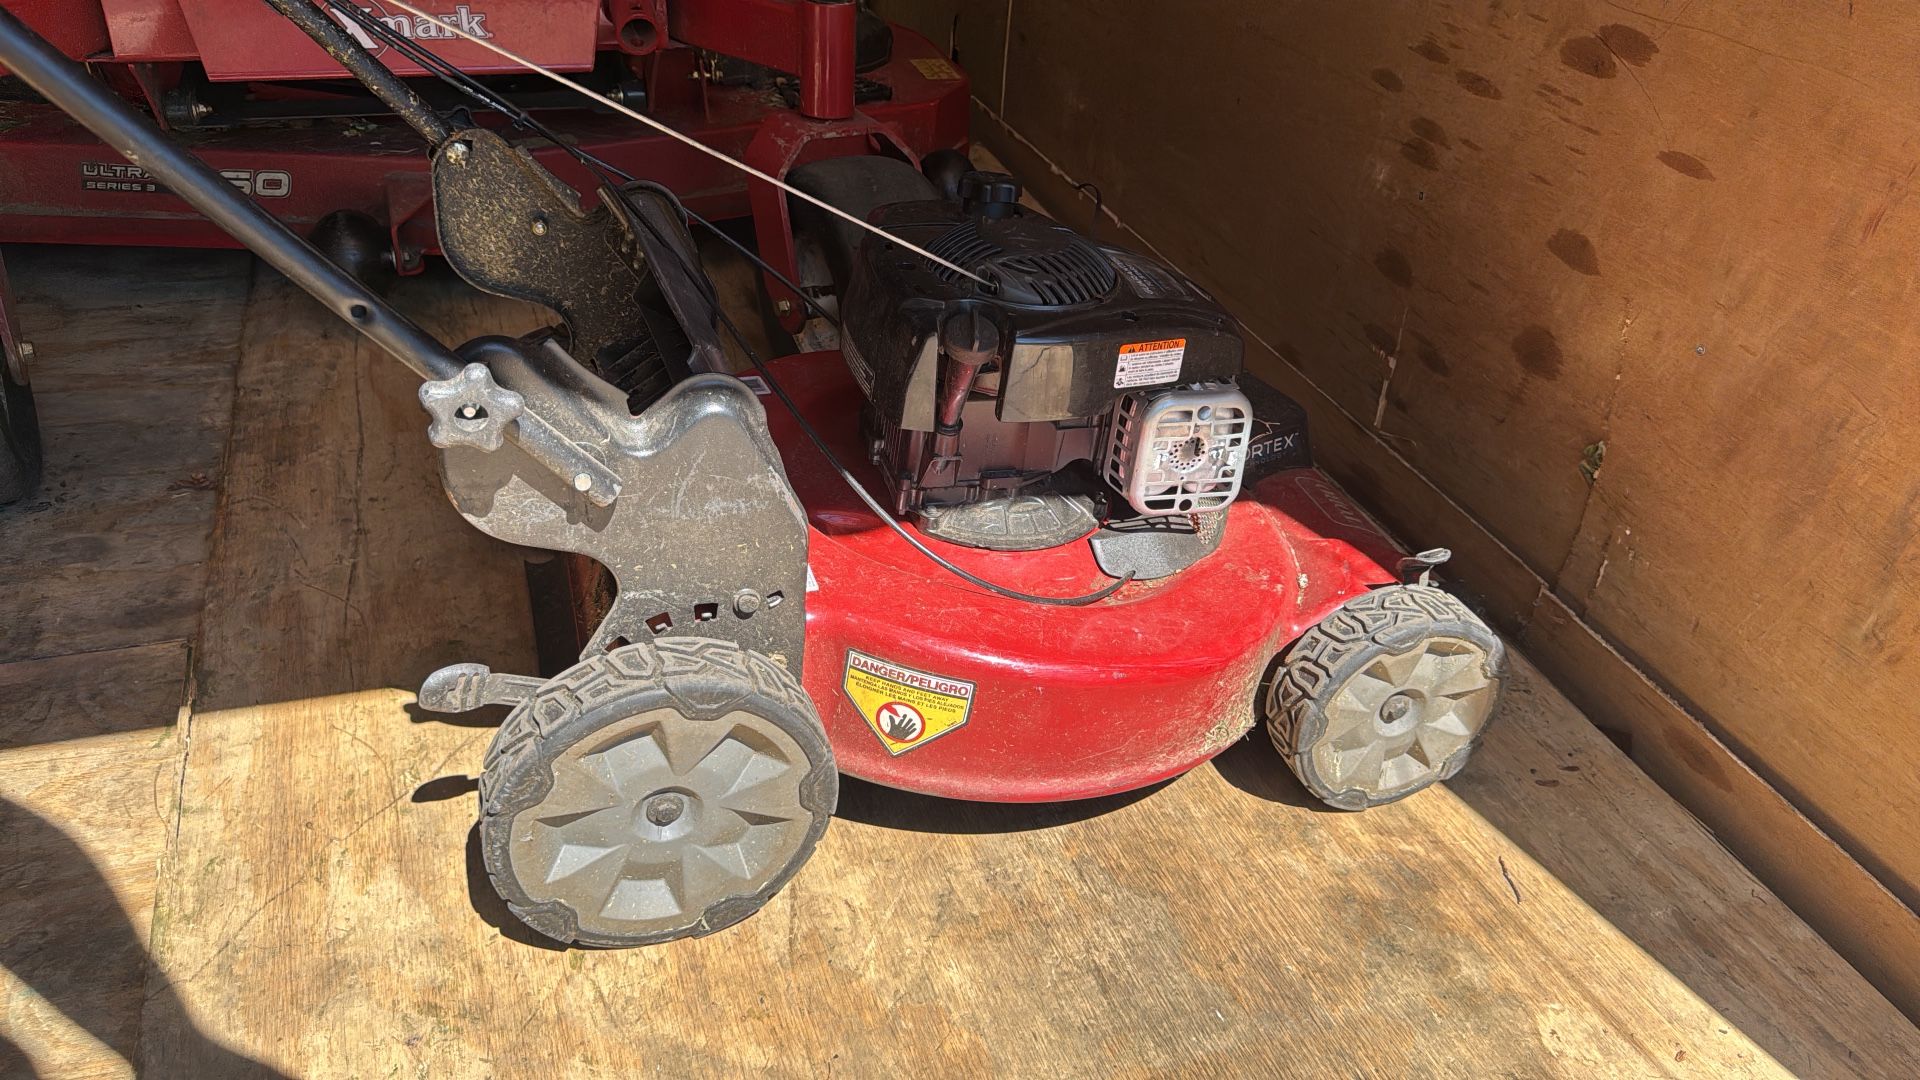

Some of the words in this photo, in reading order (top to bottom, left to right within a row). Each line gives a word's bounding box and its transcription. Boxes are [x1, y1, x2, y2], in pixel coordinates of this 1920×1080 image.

[86, 181, 143, 191] SERIES
[147, 184, 156, 192] 3
[1138, 340, 1180, 352] ATTENTION
[852, 656, 969, 696] DANGER/PELIGRO
[850, 674, 877, 687] MANTENGA
[888, 687, 908, 697] MANOS
[923, 697, 936, 705] PIES
[936, 700, 965, 710] ALEJADOS
[865, 675, 881, 684] KEEP
[881, 681, 902, 691] HANDS
[916, 690, 931, 698] FEET
[884, 691, 897, 699] LES
[897, 695, 916, 704] MAINS
